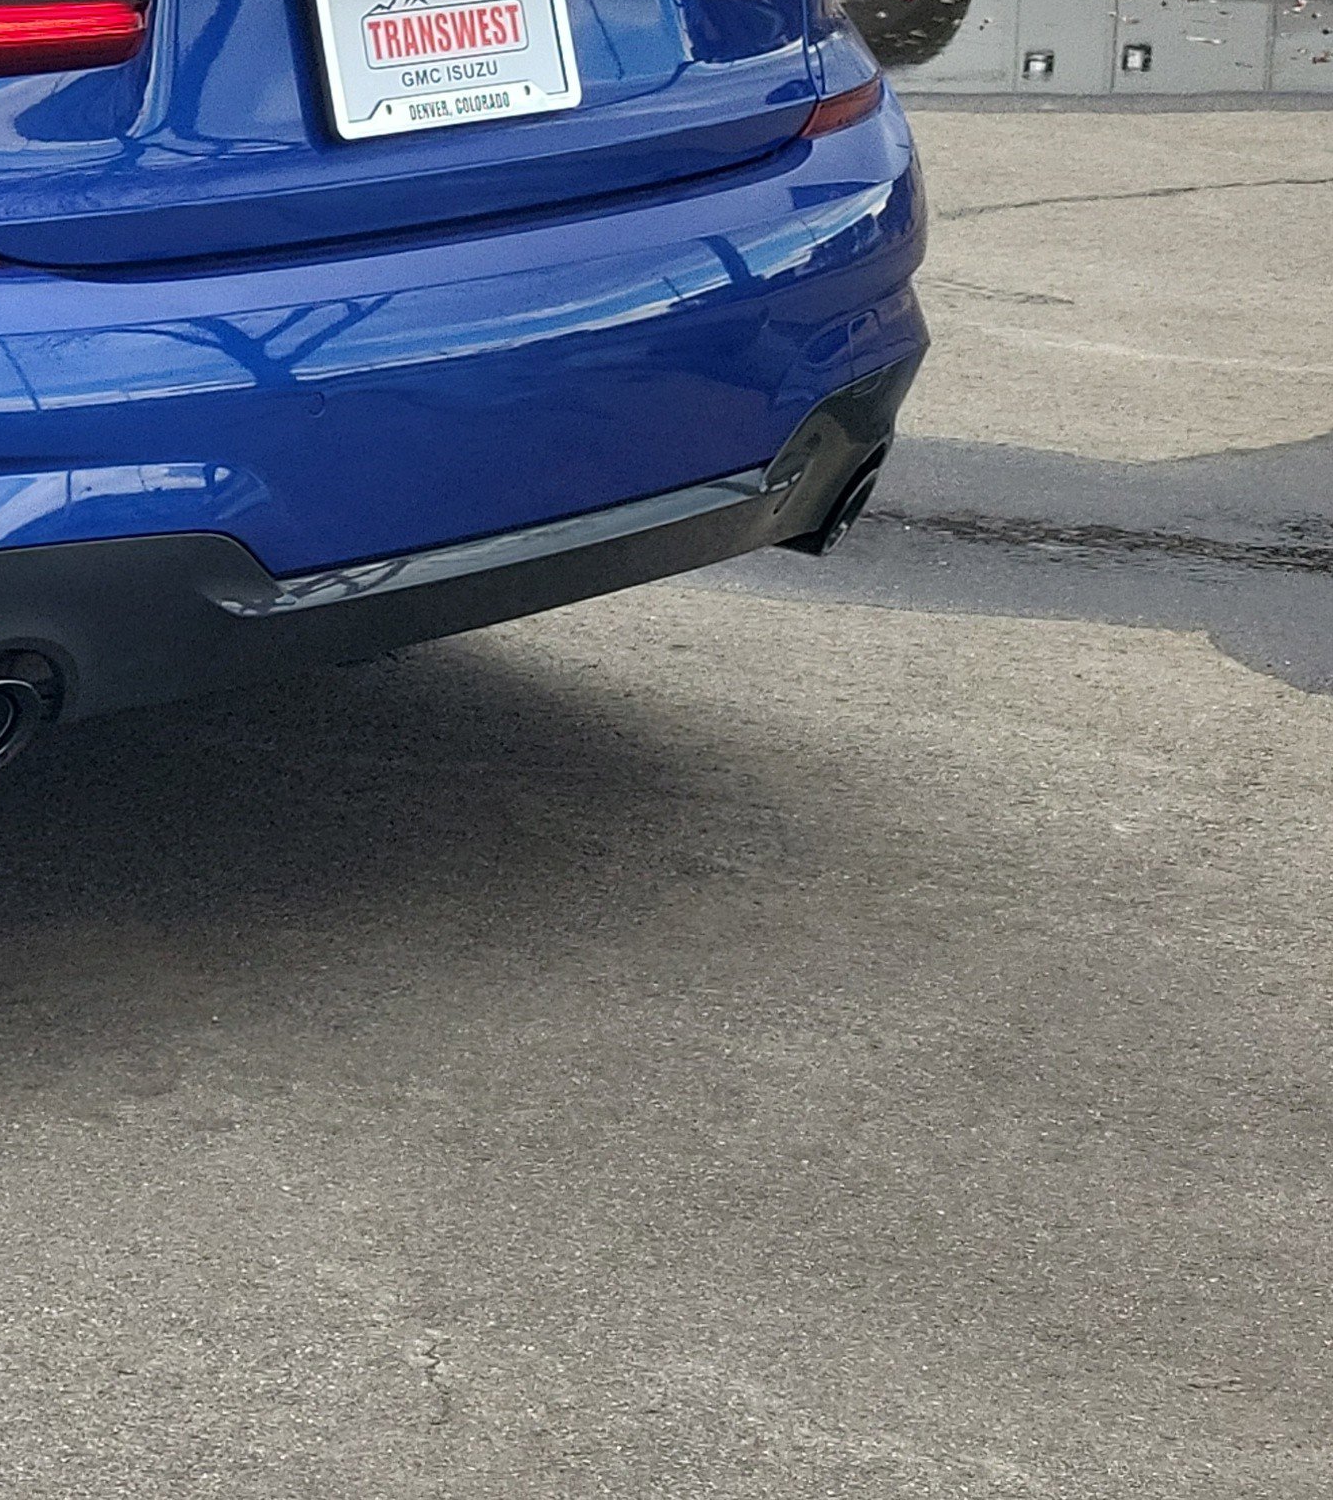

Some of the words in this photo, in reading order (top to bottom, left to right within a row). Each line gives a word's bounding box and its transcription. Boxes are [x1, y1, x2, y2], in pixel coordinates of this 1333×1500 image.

[366, 4, 521, 60] TRANSWEST
[401, 68, 442, 87] GMC
[446, 60, 498, 82] ISUZU
[408, 100, 453, 121] DENVER,
[455, 91, 510, 115] COLORADO
